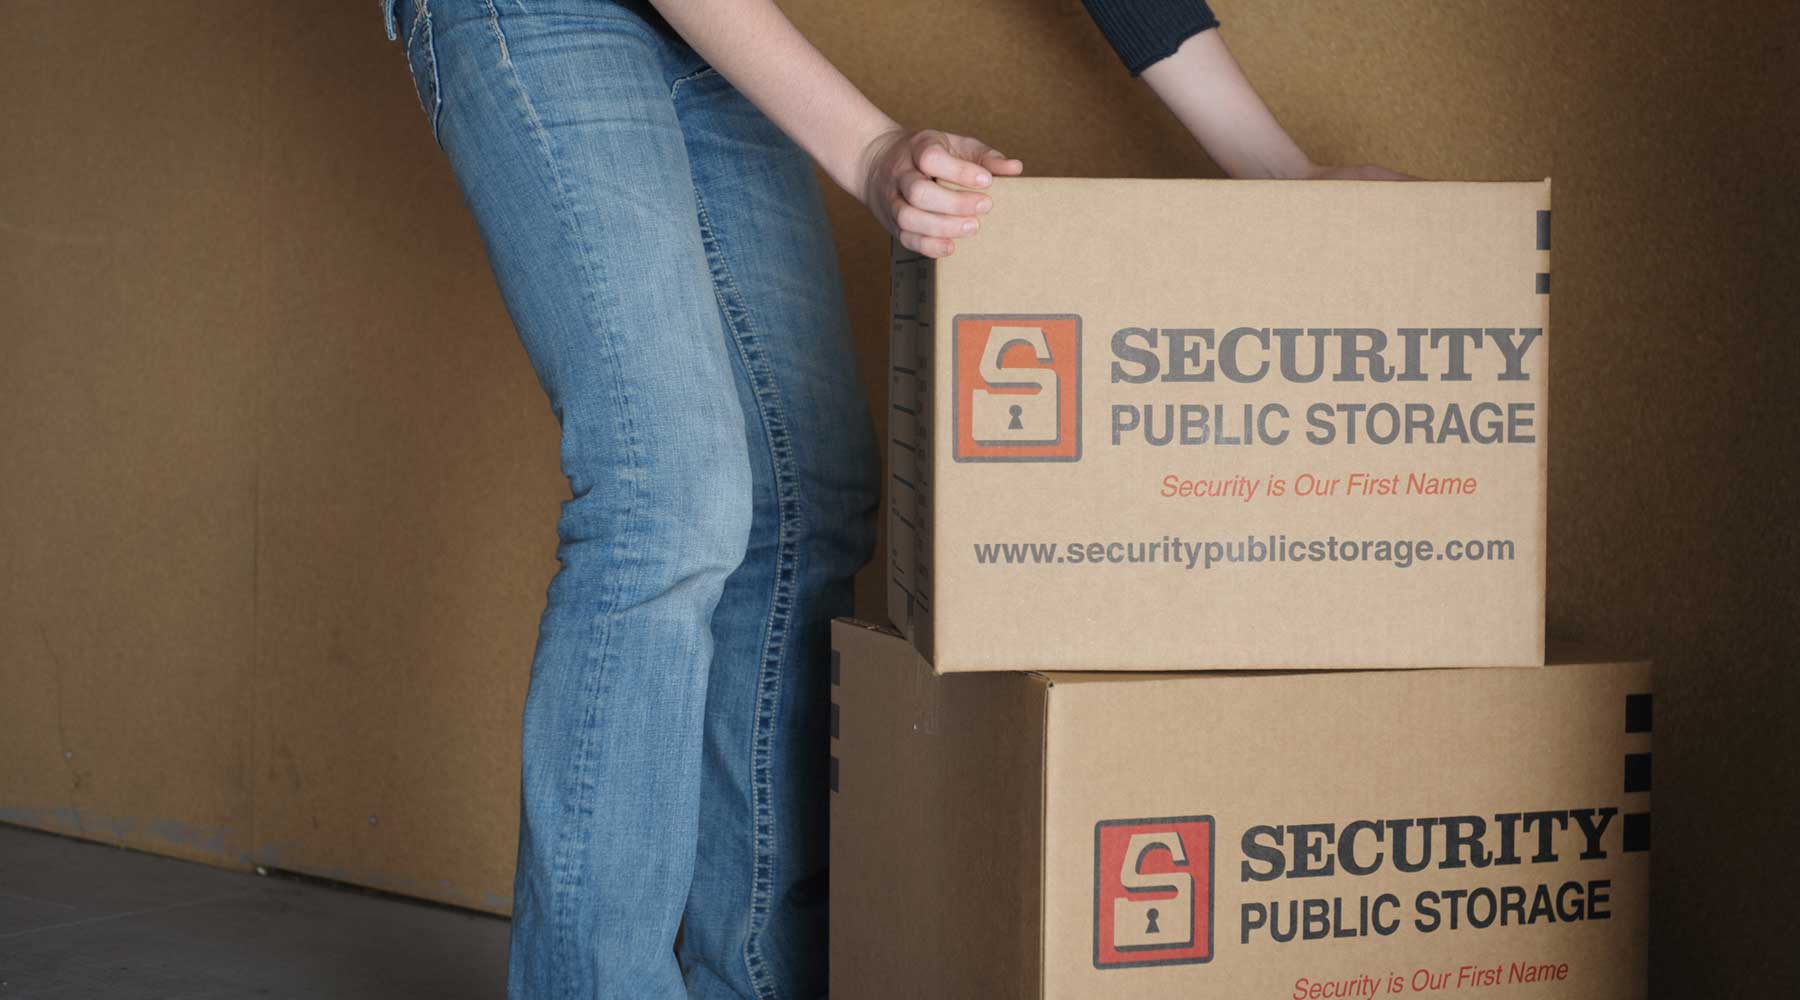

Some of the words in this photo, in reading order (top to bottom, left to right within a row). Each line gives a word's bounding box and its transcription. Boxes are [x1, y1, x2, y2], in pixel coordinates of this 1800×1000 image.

[1110, 326, 1542, 384] SECURITY
[1111, 402, 1290, 447] PUBLIC
[1305, 401, 1537, 446] STORAGE
[1160, 473, 1260, 504] Security
[1266, 473, 1286, 497] is
[1293, 473, 1341, 497] Our
[1346, 471, 1399, 497] First
[1405, 471, 1478, 497] Name
[973, 534, 1516, 570] www.securitypublicstorage.com
[1240, 806, 1619, 883] SECURITY
[1240, 893, 1401, 945] PUBLIC
[1414, 879, 1612, 934] STORAGE
[1292, 974, 1382, 1000] Security
[1387, 971, 1405, 994] is
[1411, 968, 1452, 992] Our
[1456, 964, 1504, 988] First
[1507, 960, 1569, 985] Name
